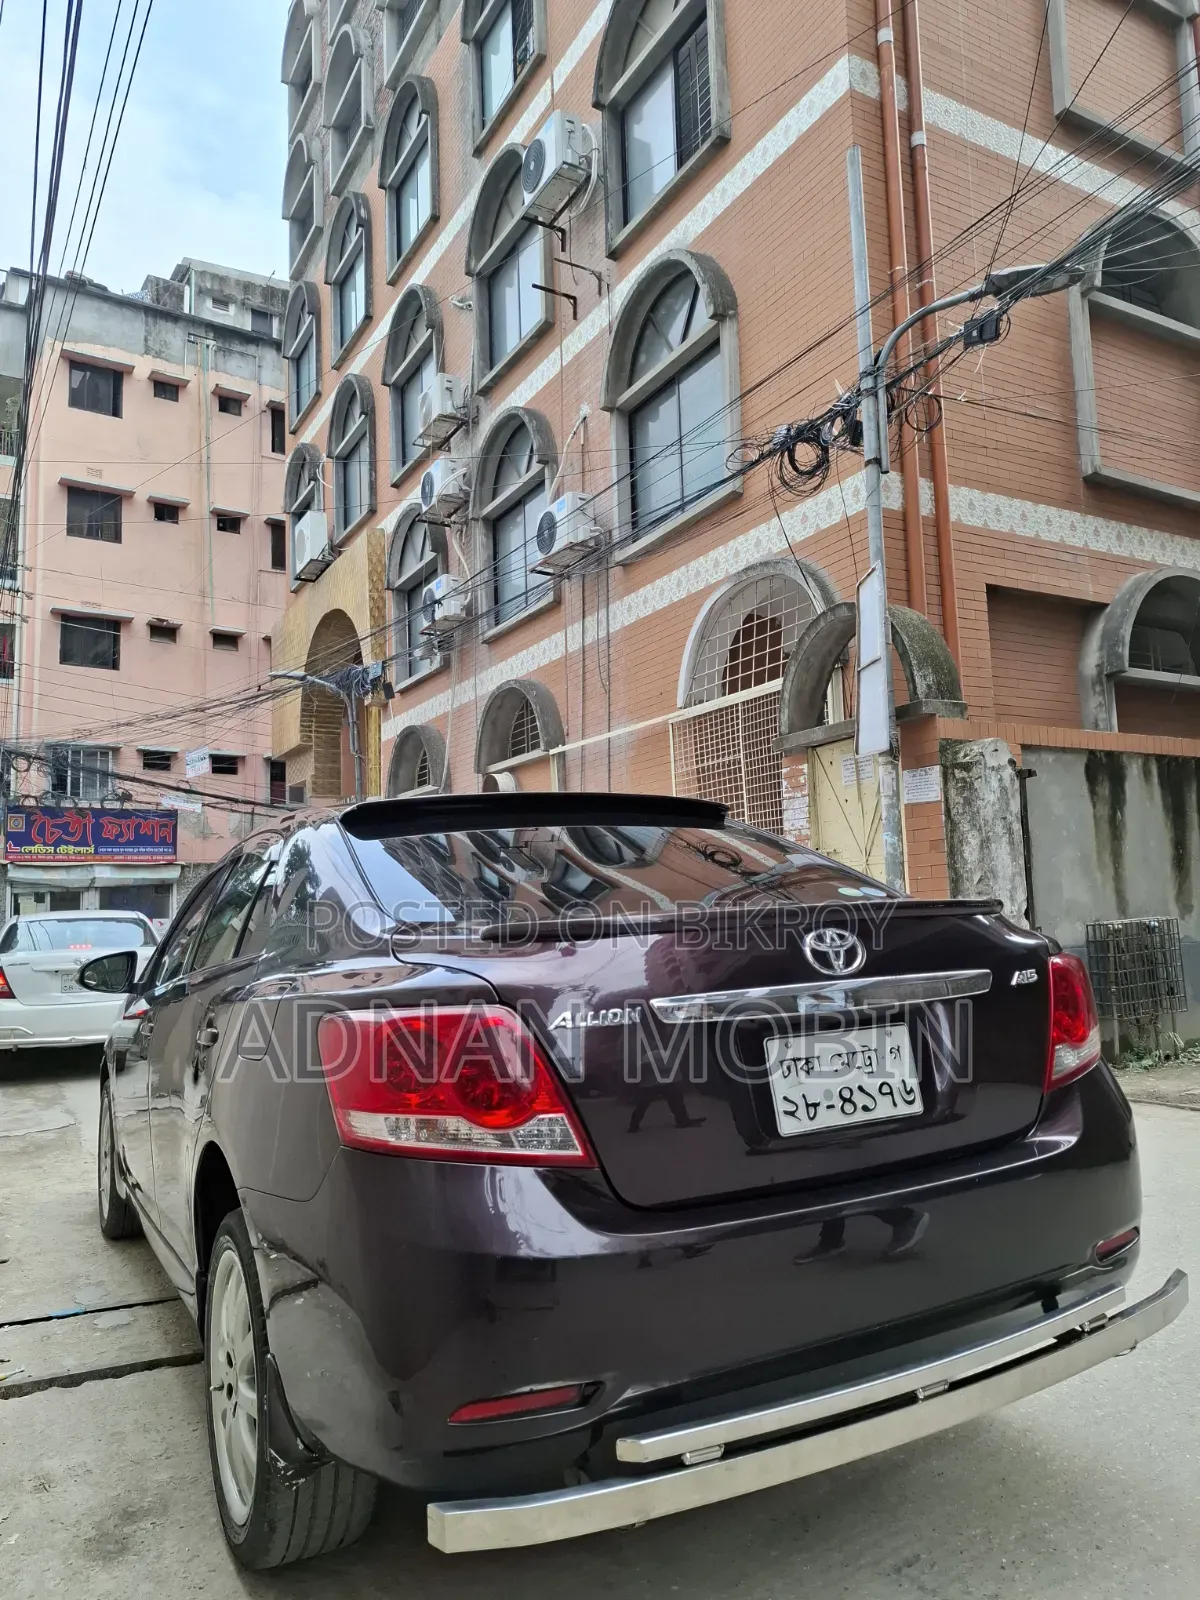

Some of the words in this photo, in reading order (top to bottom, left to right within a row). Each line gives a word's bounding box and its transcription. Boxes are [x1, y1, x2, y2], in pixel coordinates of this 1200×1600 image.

[31, 810, 95, 846] চৈতী
[99, 816, 176, 843] ফ্যাশন
[21, 844, 55, 855] লেডিস
[56, 844, 95, 855] টেইলার্স
[779, 1055, 822, 1079] ঢাকা
[829, 1044, 880, 1075] মেট্রো
[782, 1078, 916, 1122] ২৮-৪১৭৬
